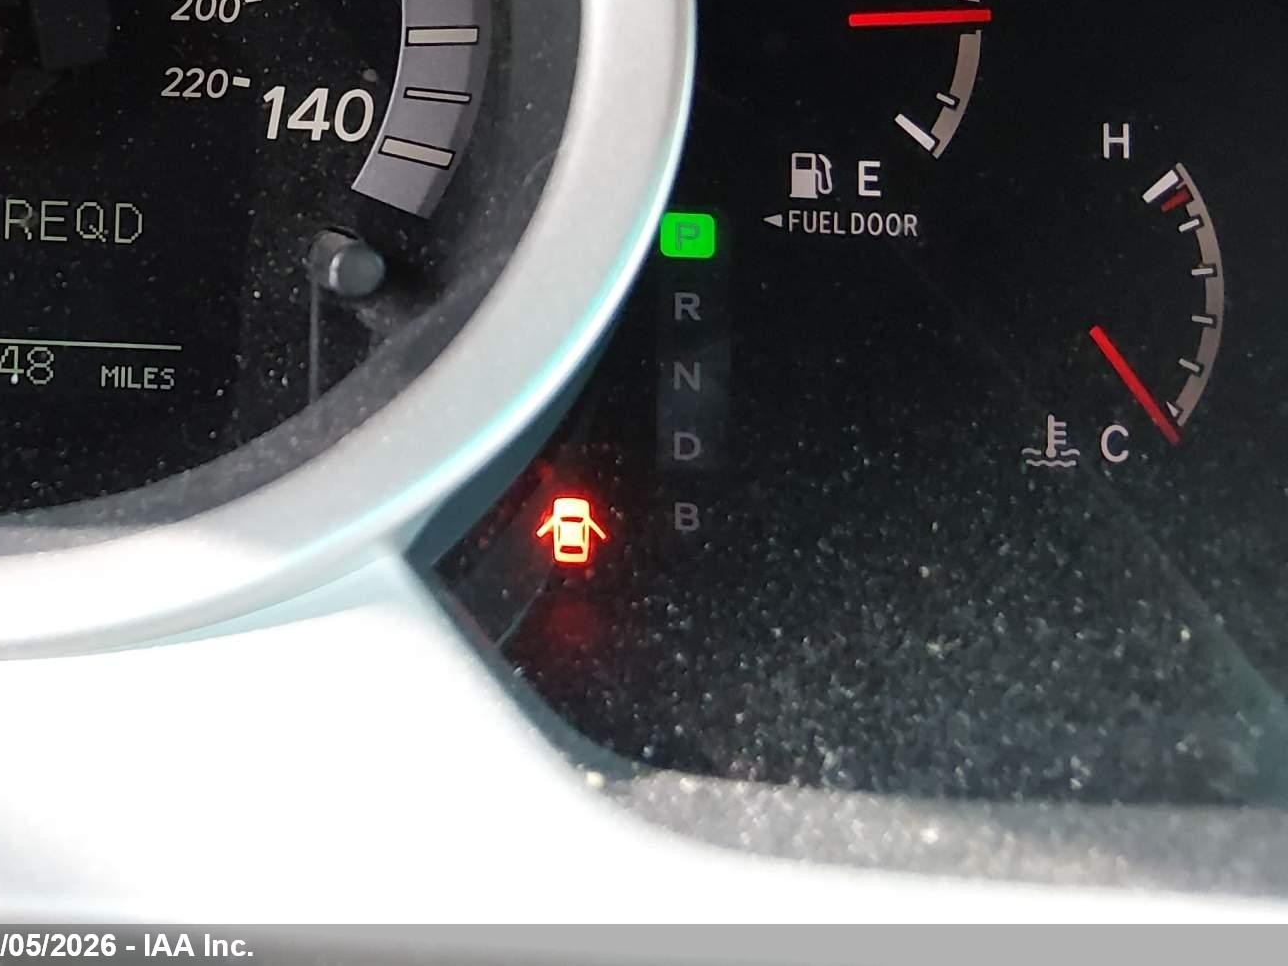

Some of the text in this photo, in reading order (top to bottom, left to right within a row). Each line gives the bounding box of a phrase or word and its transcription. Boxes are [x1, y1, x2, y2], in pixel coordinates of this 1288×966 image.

[161, 68, 228, 98] 220
[263, 86, 374, 142] 140
[1104, 123, 1129, 158] H
[859, 161, 881, 196] E
[5, 199, 142, 243] REQD
[789, 210, 917, 236] FUEL DOOR
[675, 222, 702, 251] P
[675, 293, 701, 320] R
[102, 366, 174, 389] MILES
[674, 362, 700, 391] N
[674, 432, 701, 460] D
[1101, 425, 1128, 462] C
[675, 503, 699, 534] B
